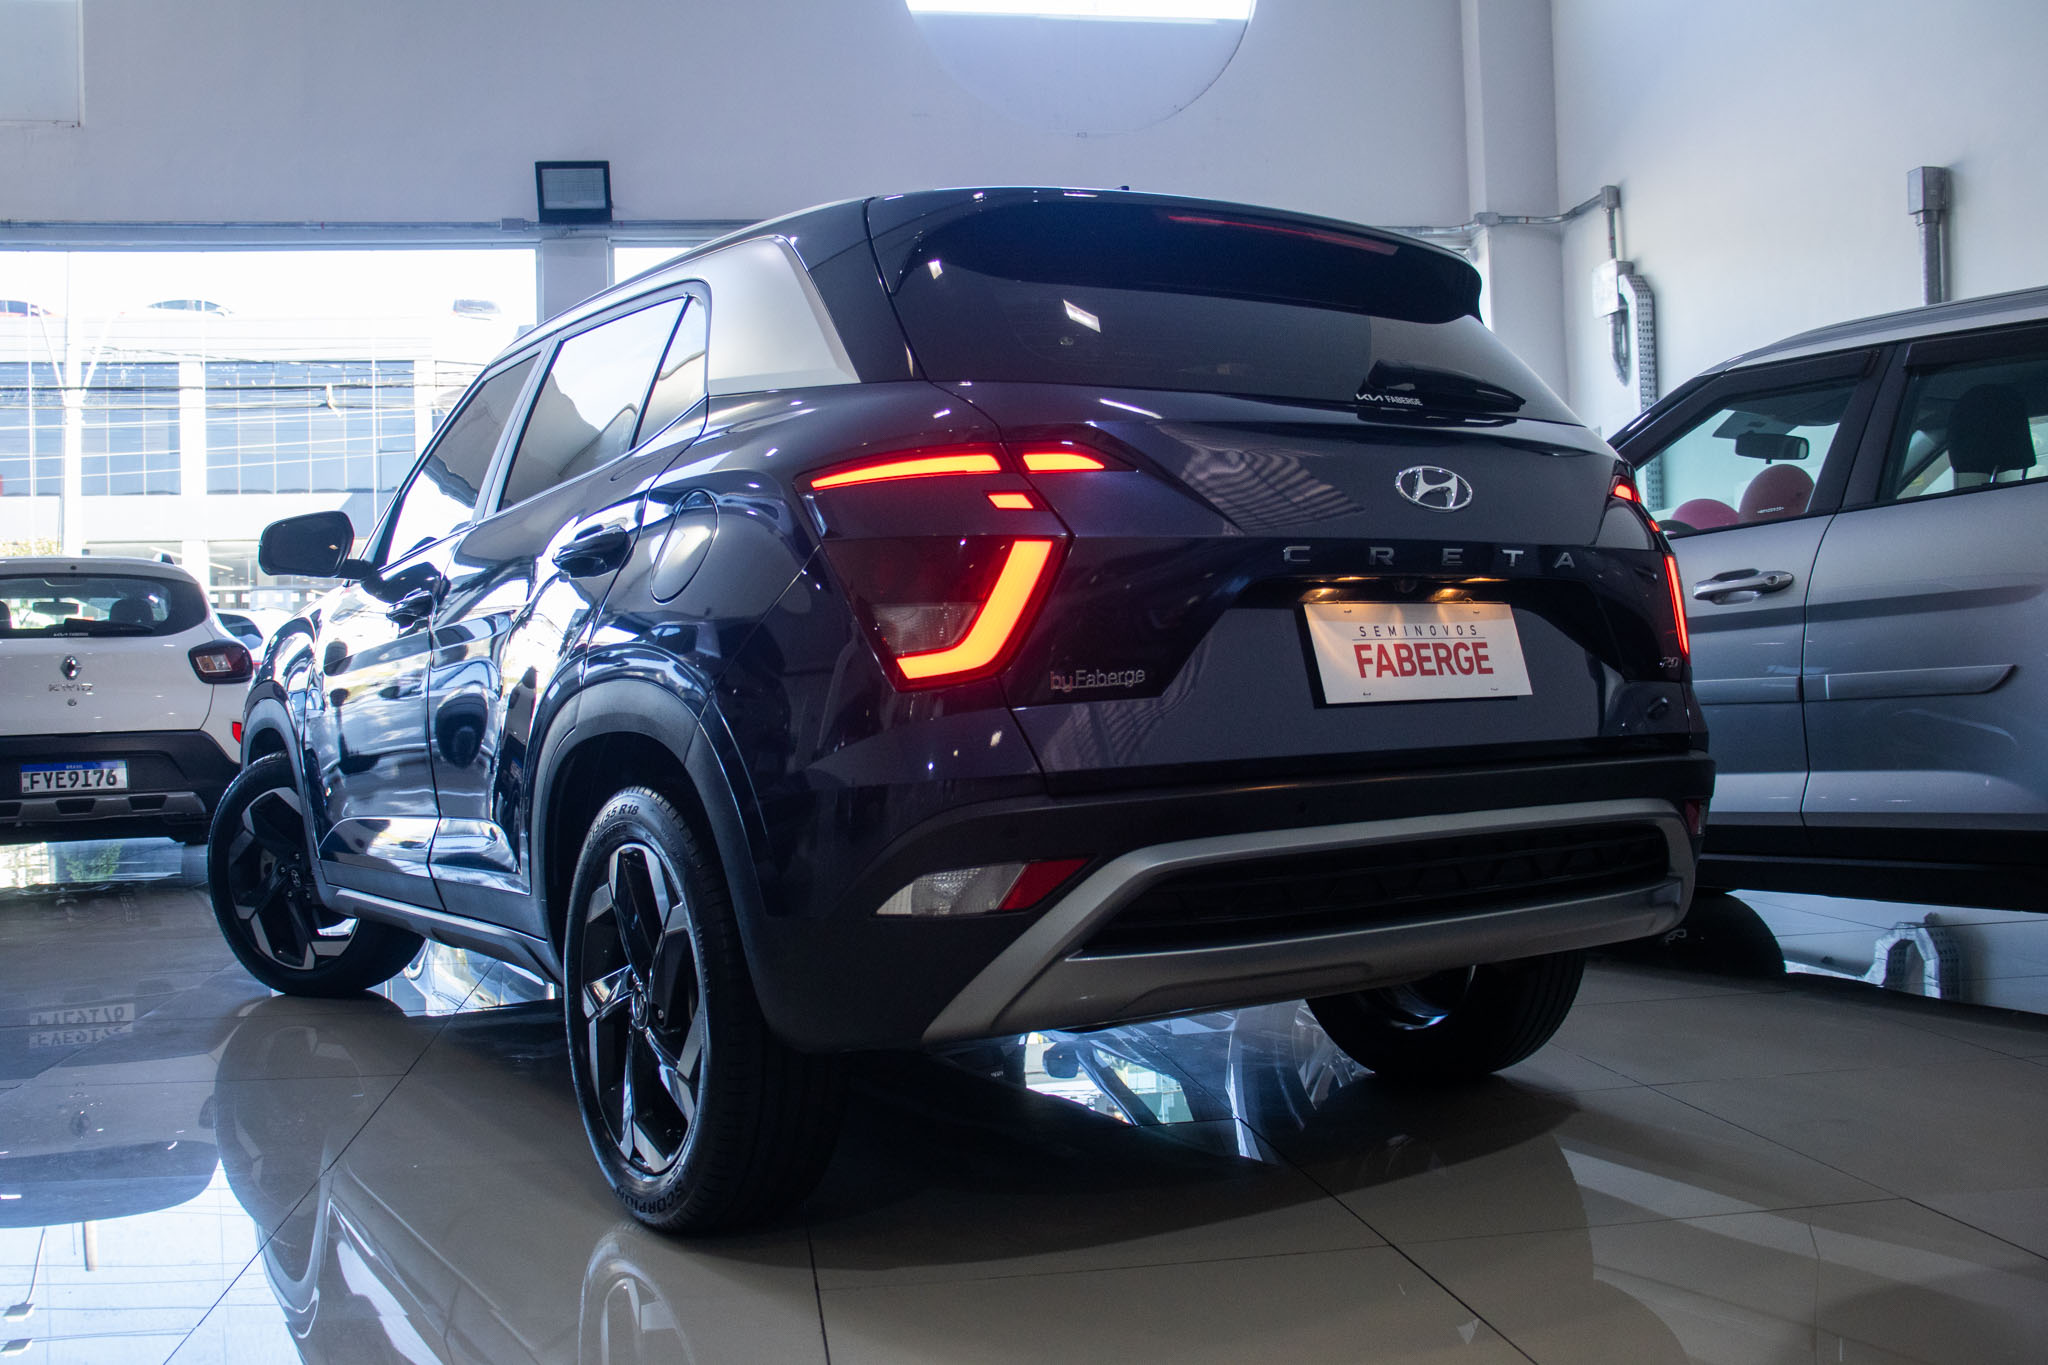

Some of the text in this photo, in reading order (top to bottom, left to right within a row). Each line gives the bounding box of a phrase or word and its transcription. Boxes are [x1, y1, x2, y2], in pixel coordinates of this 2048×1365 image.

[1384, 395, 1424, 407] FABERGE
[1283, 545, 1576, 569] CRETA
[1359, 624, 1477, 638] SEMINOVOS
[1353, 642, 1494, 679] FABERGE
[30, 769, 118, 790] FYE9I76
[619, 804, 640, 816] R18
[616, 1180, 682, 1215] SCORPION
